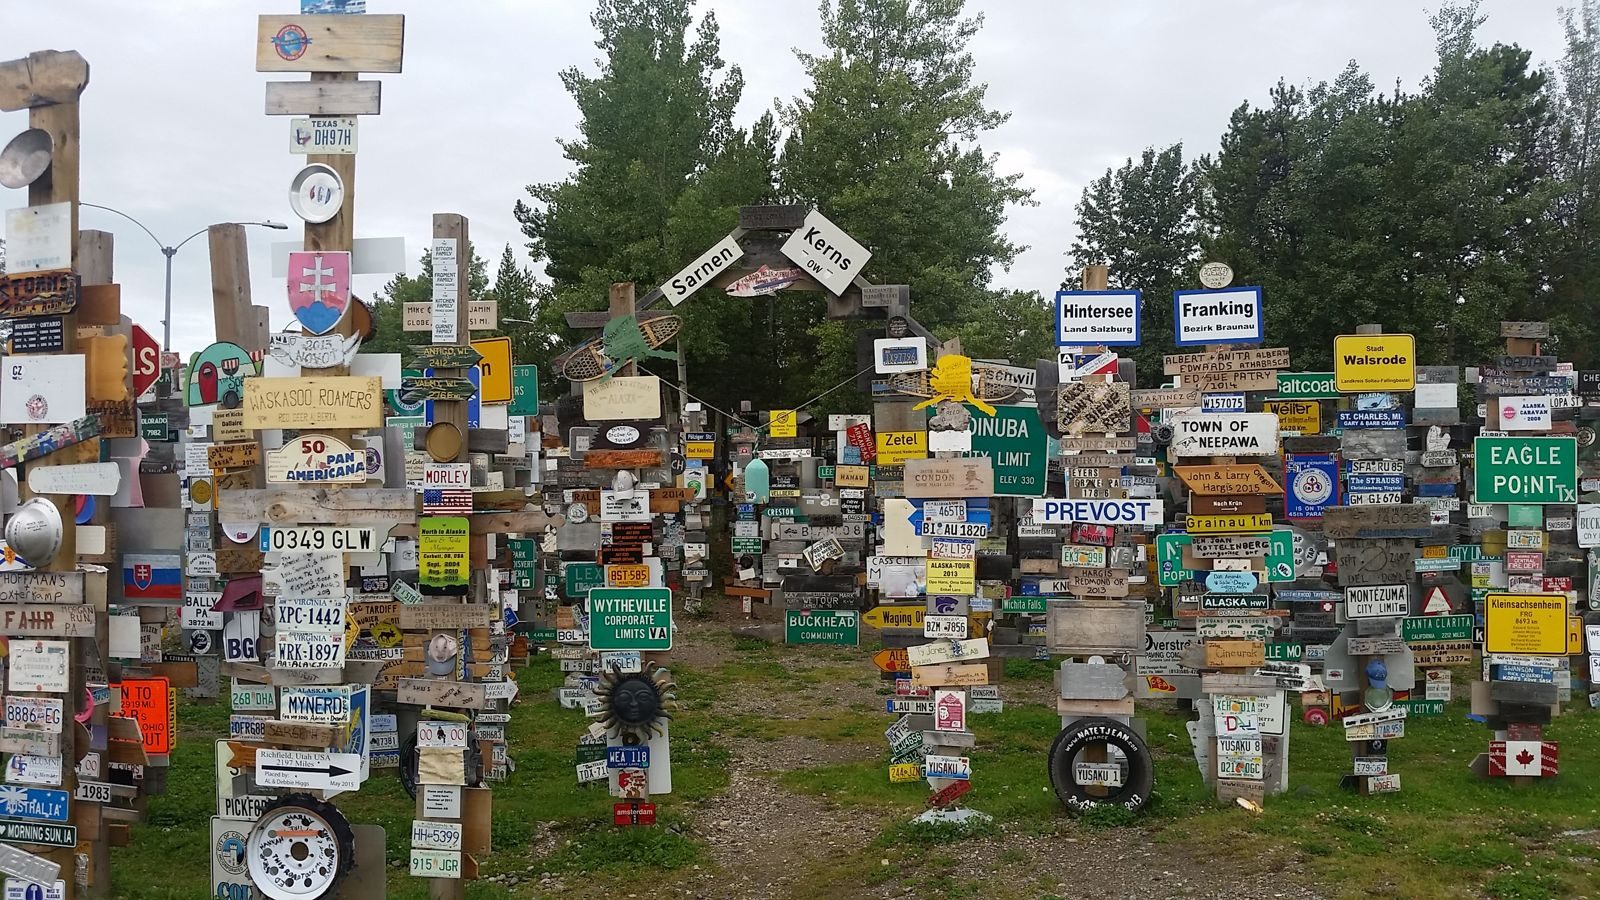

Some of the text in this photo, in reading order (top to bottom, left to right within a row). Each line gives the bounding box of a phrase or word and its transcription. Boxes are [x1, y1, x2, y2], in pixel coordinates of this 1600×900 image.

[315, 129, 351, 145] DH97H
[803, 226, 851, 271] Kerns
[672, 247, 733, 295] Sarnen
[1064, 304, 1133, 318] Hintersee
[1183, 301, 1253, 318] Franking
[1091, 325, 1133, 334] Salzburg
[1184, 323, 1254, 333] Bezirk Braunau
[1165, 354, 1204, 365] ALBERT
[1218, 352, 1250, 361] ANITA
[1343, 355, 1406, 365] Walsrode
[1180, 359, 1288, 373] EDWARDS ATHABASCA
[250, 390, 372, 410] WASKASOO ROAMERS
[1136, 393, 1184, 402] MARTINEZ
[1203, 398, 1243, 408] W157075
[1353, 413, 1388, 421] CHARLES,
[1181, 421, 1249, 432] TOWN OF
[886, 434, 918, 446] Zetel
[1199, 436, 1259, 448] NEEPAWA
[302, 441, 325, 454] 50
[327, 452, 355, 465] PAN
[997, 452, 1032, 467] LIMIT
[1491, 446, 1561, 465] EAGLE
[1391, 460, 1403, 470] 85
[286, 462, 365, 481] AMERICANA
[426, 471, 468, 483] MORLEY
[915, 473, 954, 482] CONDON
[1000, 476, 1017, 484] ELEV
[1188, 469, 1274, 489] John Larry Oregon
[1494, 475, 1557, 494] POINT
[1203, 483, 1260, 493] Hargis 2015
[663, 490, 684, 499] 2014
[1382, 493, 1400, 503] 676
[768, 508, 794, 516] CRESTON
[1045, 502, 1151, 521] PREVOST
[1187, 516, 1271, 529] Grainau 1 km
[923, 523, 986, 536] BI AU 1820
[274, 529, 370, 549] 0349 GLW
[1082, 569, 1112, 577] HARGIS
[1074, 577, 1110, 585] REDMOND
[1349, 589, 1404, 603] MONTEZUMA
[294, 600, 327, 608] VIRGINIA
[594, 599, 666, 612] WYTHEVILLE
[1004, 599, 1025, 609] Wichita
[1205, 599, 1247, 607] ALASKA
[1357, 604, 1373, 614] CITY
[1491, 599, 1562, 609] Kleinsachsenheim
[196, 610, 208, 618] PA
[365, 605, 397, 615] TARDIFF
[5, 611, 55, 630] FAHR
[279, 609, 341, 627] XPC-1442
[604, 615, 654, 625] CORPORATE
[790, 615, 855, 628] BUCKHEAD
[883, 611, 912, 627] Waging
[1406, 616, 1471, 630] SANTA CLARITA
[615, 627, 667, 639] LIMITS VA
[801, 631, 844, 640] COMMUNITY
[137, 687, 152, 700] TO
[233, 692, 273, 705] 268 DHA
[289, 696, 341, 715] MYNERD
[1414, 703, 1430, 713] CITY
[1220, 740, 1251, 752] YUSAKU
[260, 751, 331, 763] Richfield, Utah USA
[609, 751, 625, 762] WEA
[631, 751, 647, 762] 118
[276, 759, 292, 767] 2197
[929, 762, 958, 775] YUSAKU
[1077, 769, 1108, 781] YUSAKU
[330, 781, 355, 790] May 2015
[82, 785, 110, 800] 1983
[5, 801, 61, 817] AUSTRALIA
[616, 808, 653, 816] amsterdam
[7, 825, 63, 843] MORNING SUN,
[412, 858, 459, 872] 915 JGR
